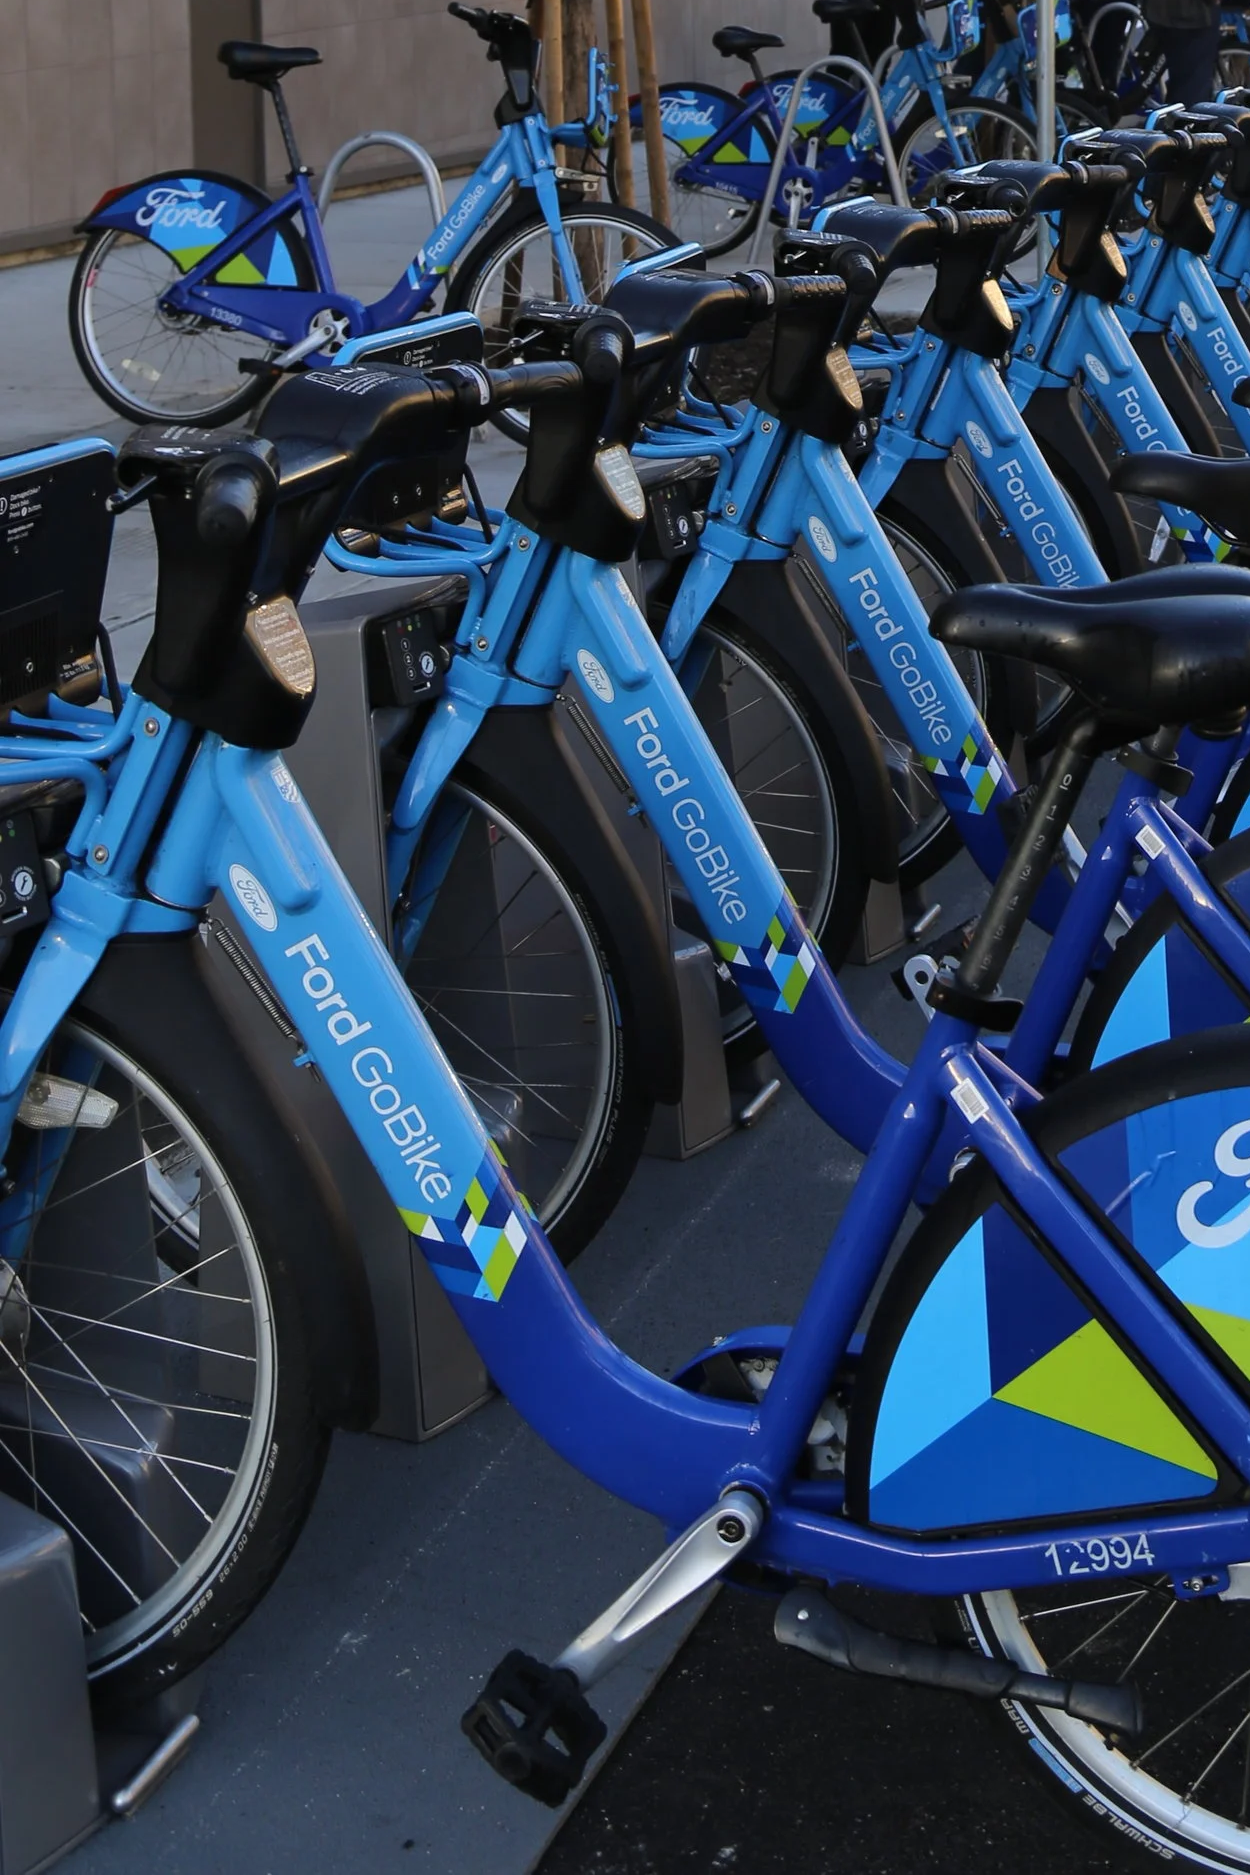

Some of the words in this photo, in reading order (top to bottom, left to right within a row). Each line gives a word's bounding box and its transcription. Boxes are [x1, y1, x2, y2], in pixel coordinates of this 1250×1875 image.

[660, 96, 713, 126] Ford
[773, 83, 826, 112] Frd
[135, 188, 227, 229] Ford
[427, 225, 455, 261] Ford
[448, 184, 487, 229] GoBike
[1206, 326, 1244, 375] Ford
[1116, 385, 1159, 440] Ford
[969, 427, 989, 453] Ford
[811, 525, 831, 555] Ford
[997, 458, 1045, 521] Ford
[1031, 521, 1081, 589] GoBik
[582, 660, 607, 693] Ford
[849, 566, 904, 642] Ford
[889, 641, 952, 746] GoBike
[1062, 773, 1072, 787] 0
[623, 706, 690, 798] Ford
[671, 797, 748, 925] GoBike
[1050, 805, 1057, 817] 1
[1036, 834, 1046, 847] 2
[1022, 865, 1032, 878] 3
[235, 878, 269, 920] Ford
[284, 932, 373, 1046] Ford
[350, 1046, 452, 1204] GoBike
[605, 1108, 620, 1144] PLUS
[1044, 1533, 1156, 1576] 12994
[171, 1589, 214, 1638] 50-559
[1082, 1793, 1176, 1861] SCHWALBE
